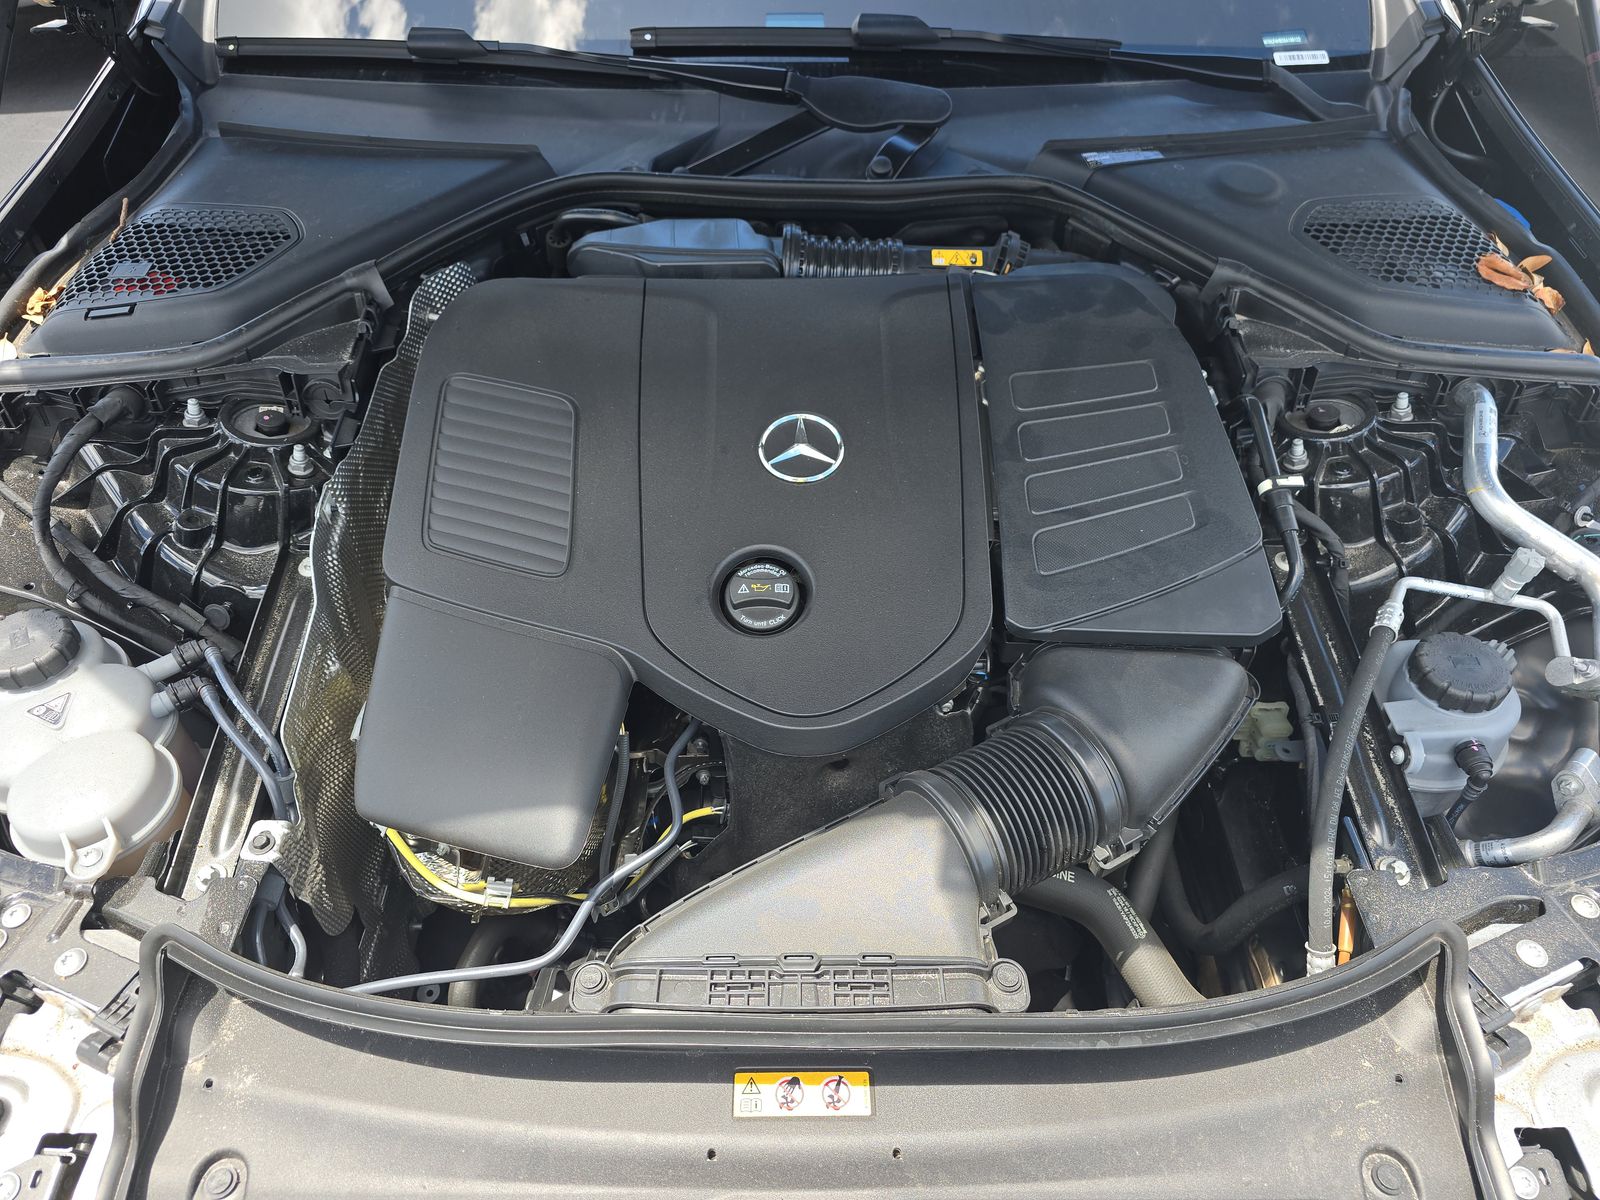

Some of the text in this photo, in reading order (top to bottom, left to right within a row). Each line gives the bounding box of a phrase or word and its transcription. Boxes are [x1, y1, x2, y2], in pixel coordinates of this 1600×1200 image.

[737, 564, 779, 577] Mercedes-Benz
[744, 568, 781, 577] recommended
[740, 615, 752, 625] Turn
[768, 614, 786, 625] CLICK
